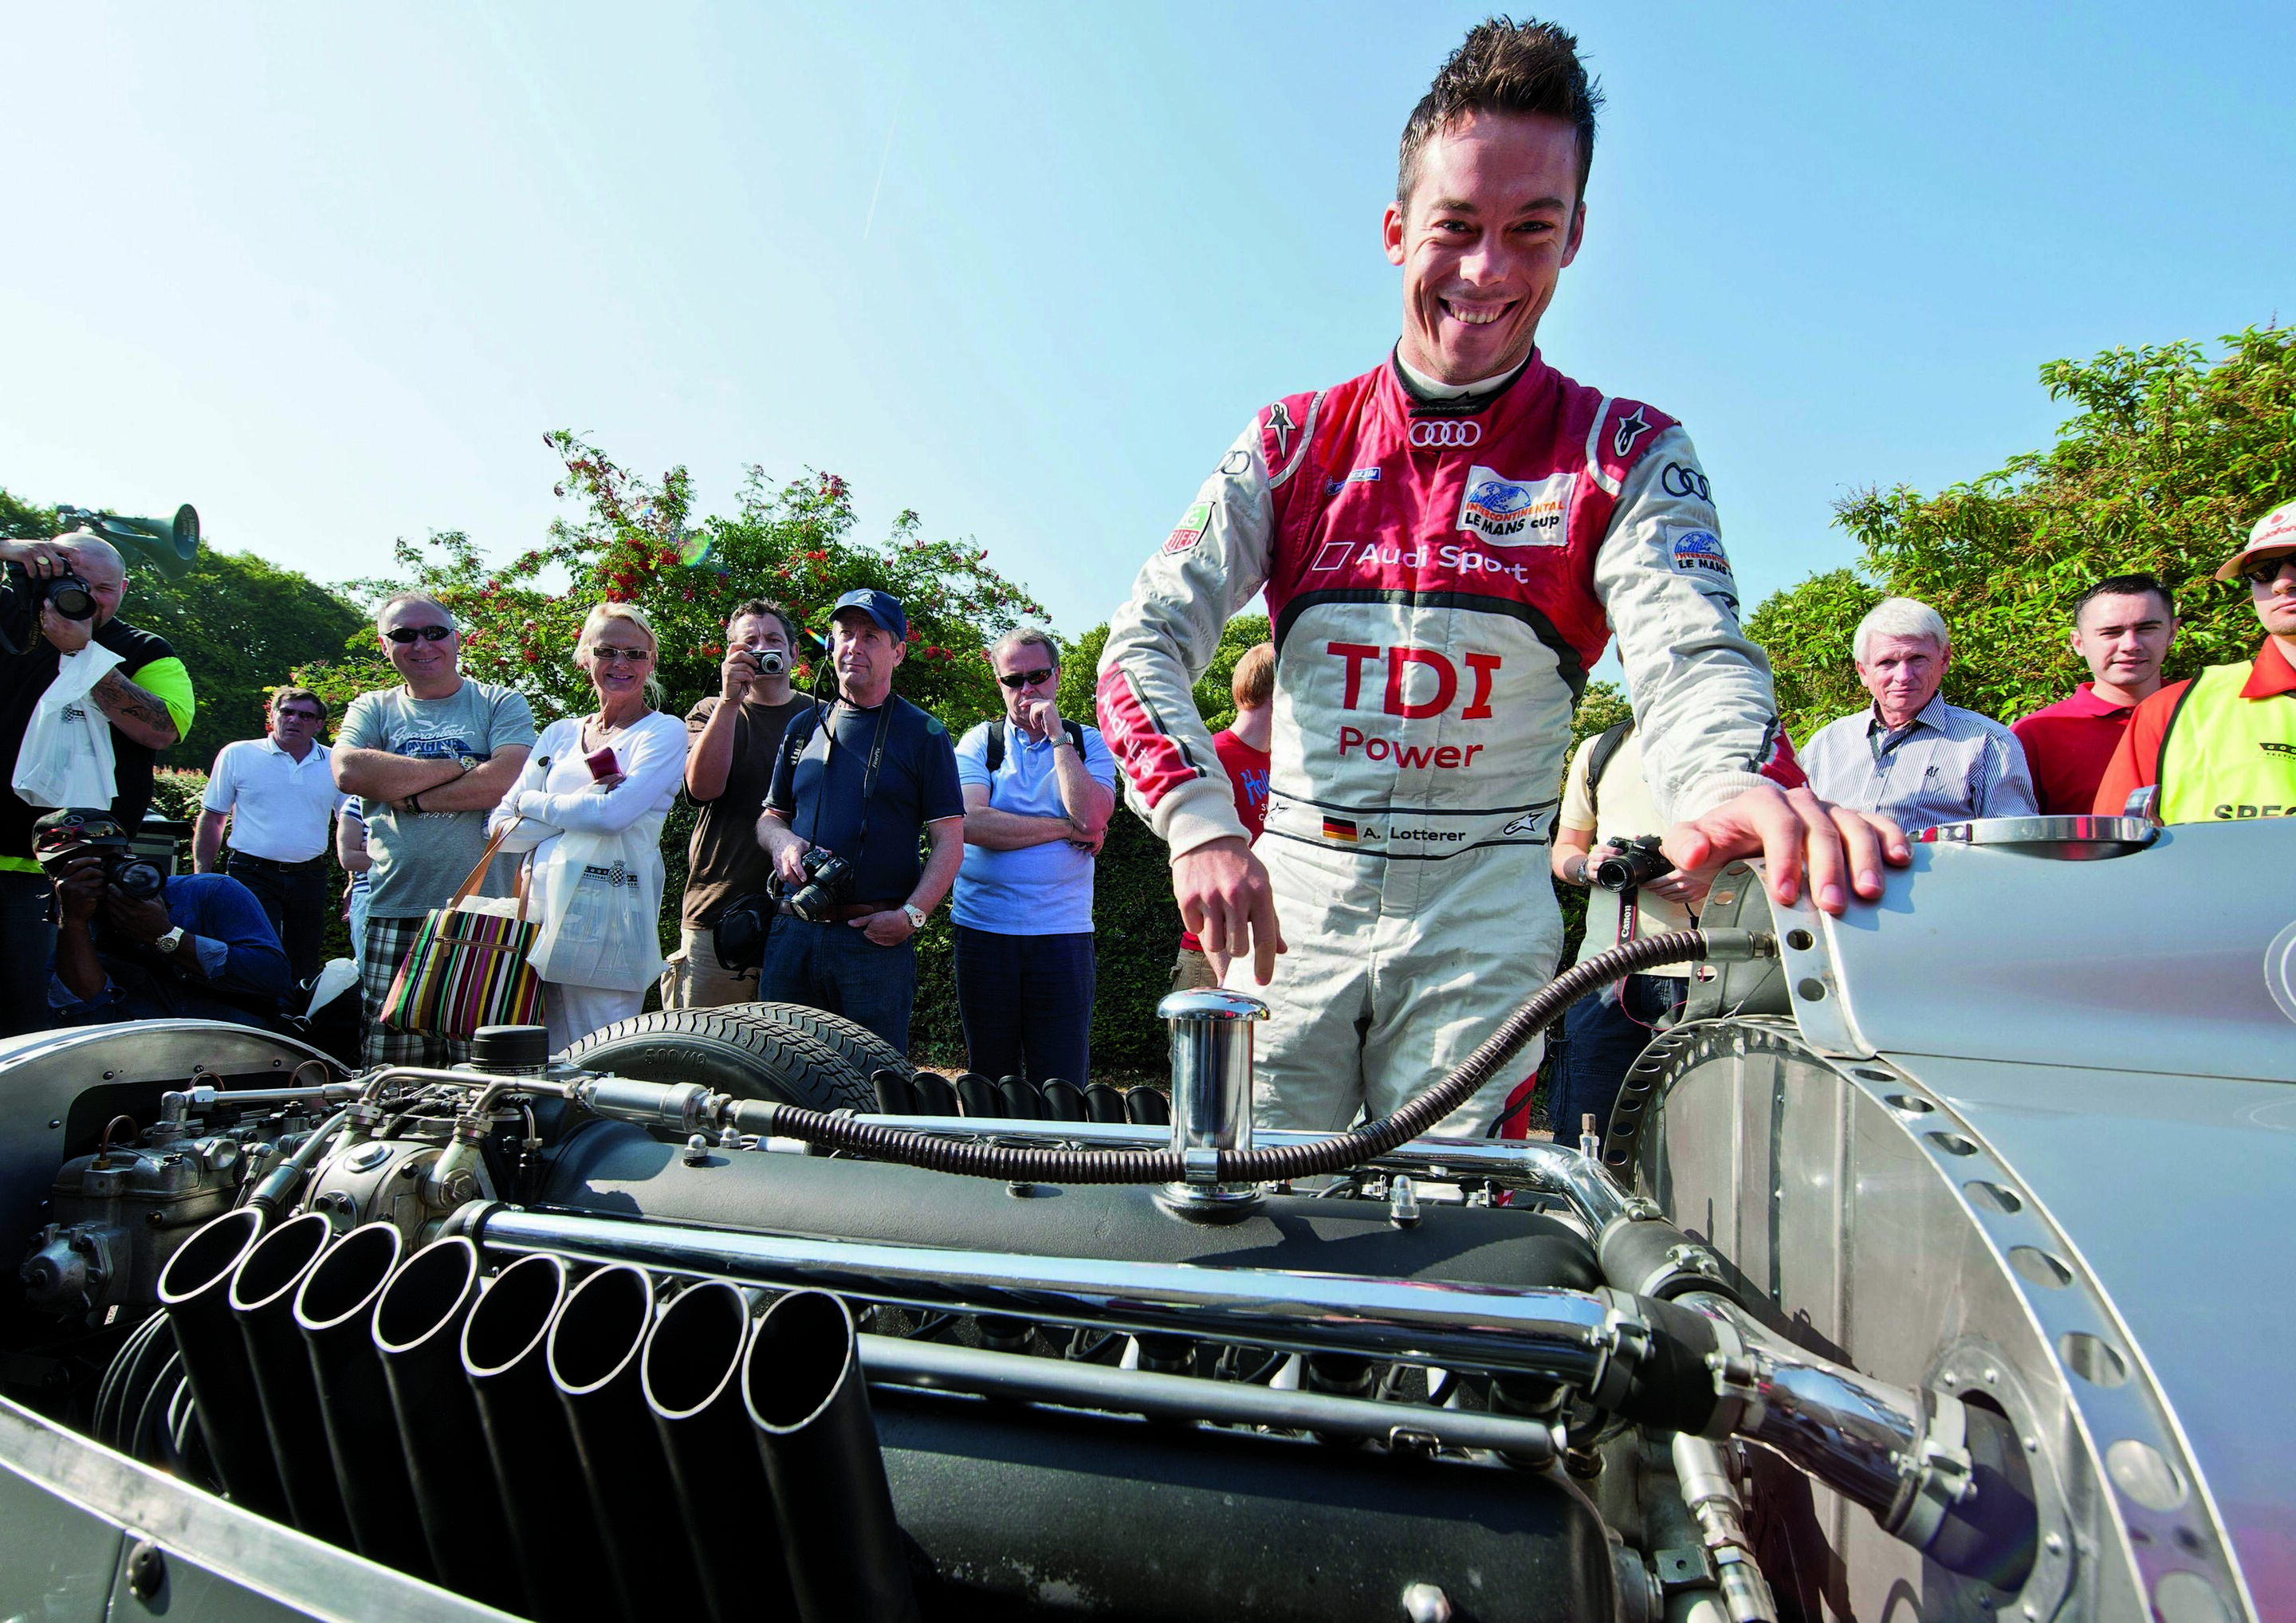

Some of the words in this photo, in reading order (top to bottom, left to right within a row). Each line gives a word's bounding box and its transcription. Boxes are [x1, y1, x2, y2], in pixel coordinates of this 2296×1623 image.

[1466, 501, 1565, 521] INTERCONTINENTAL
[1464, 512, 1480, 527] LE
[1480, 518, 1526, 536] MANS
[1355, 543, 1429, 568] Audi
[1678, 559, 1695, 569] LE
[1698, 559, 1728, 576] MANS
[1327, 642, 1502, 721] TDI
[1100, 690, 1131, 742] Audi
[389, 725, 475, 748] Guaranteed
[1339, 725, 1484, 770] Power
[872, 748, 881, 768] FinePix
[1363, 827, 1381, 839] A.
[1390, 827, 1466, 842] Lotterer
[1621, 905, 1632, 938] Canon
